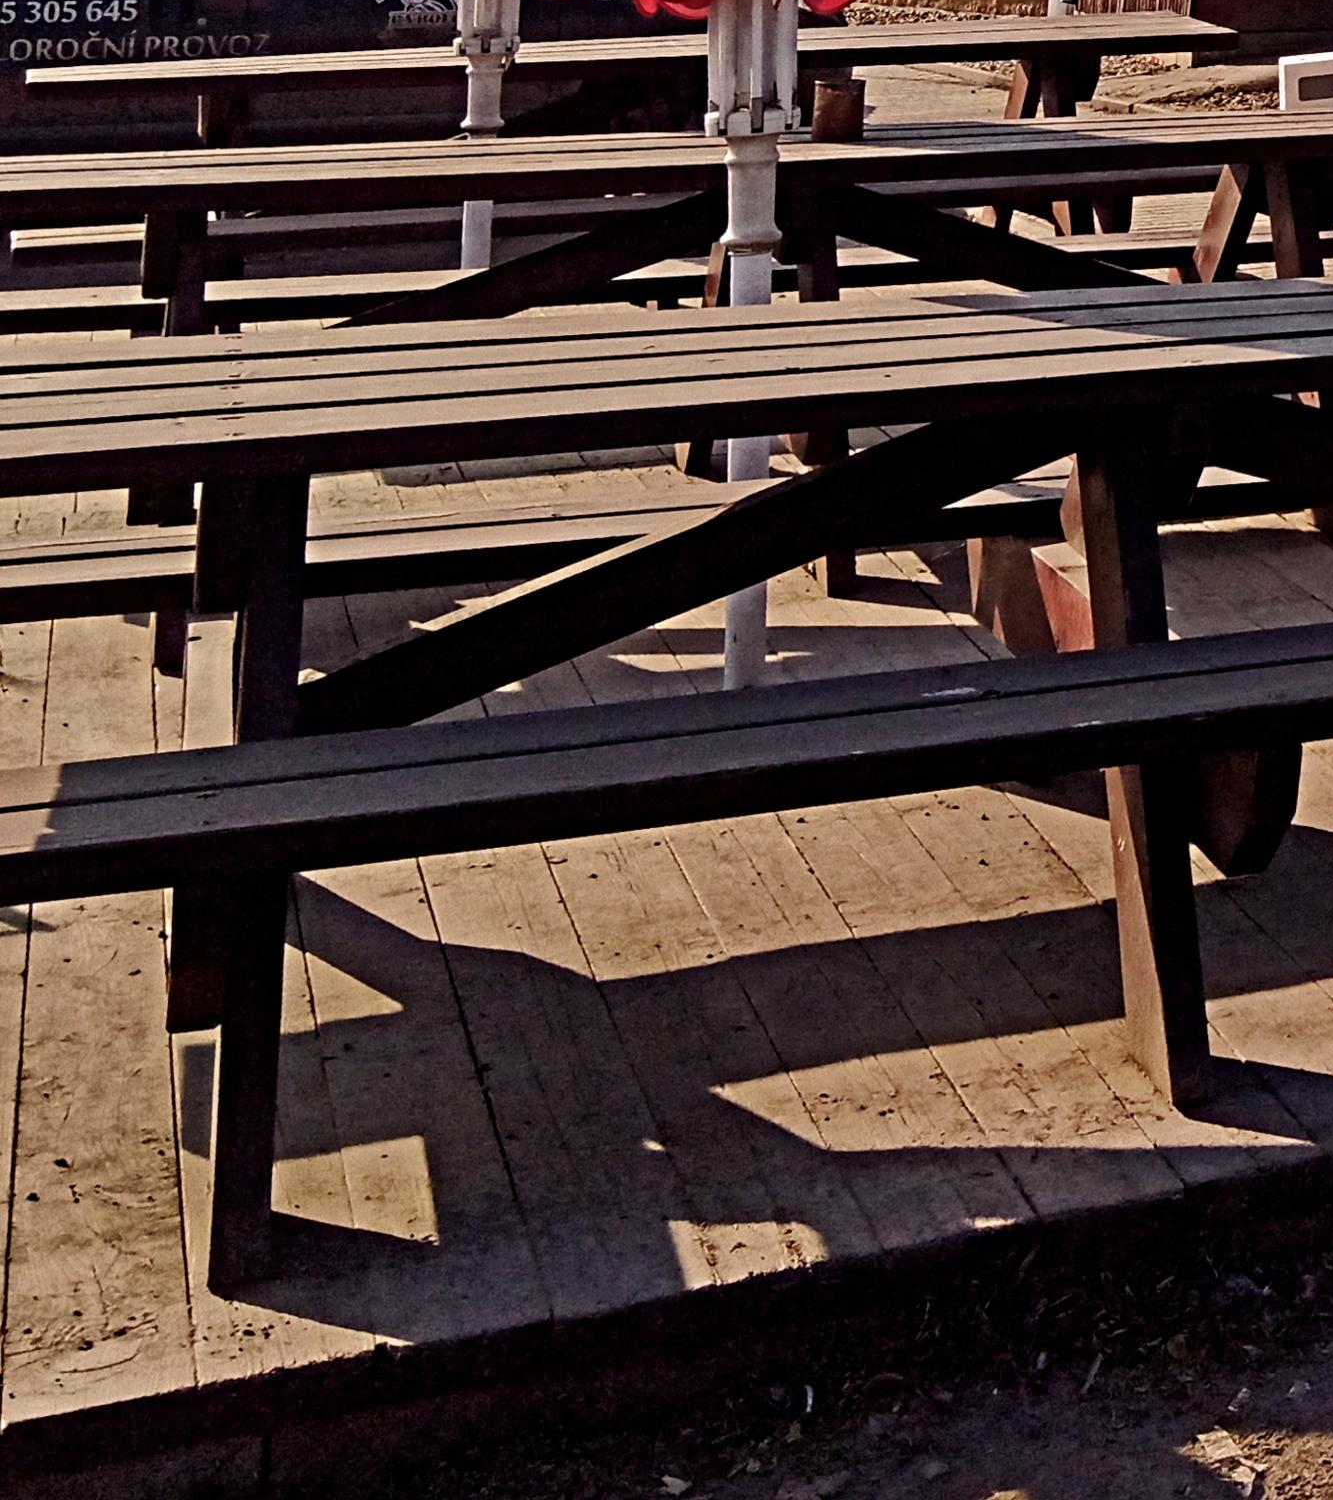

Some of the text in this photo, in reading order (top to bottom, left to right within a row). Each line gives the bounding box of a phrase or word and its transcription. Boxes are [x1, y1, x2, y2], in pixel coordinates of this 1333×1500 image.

[0, 0, 138, 24] 5 305 645
[0, 29, 270, 63] OROČNÍ PROVOZ
